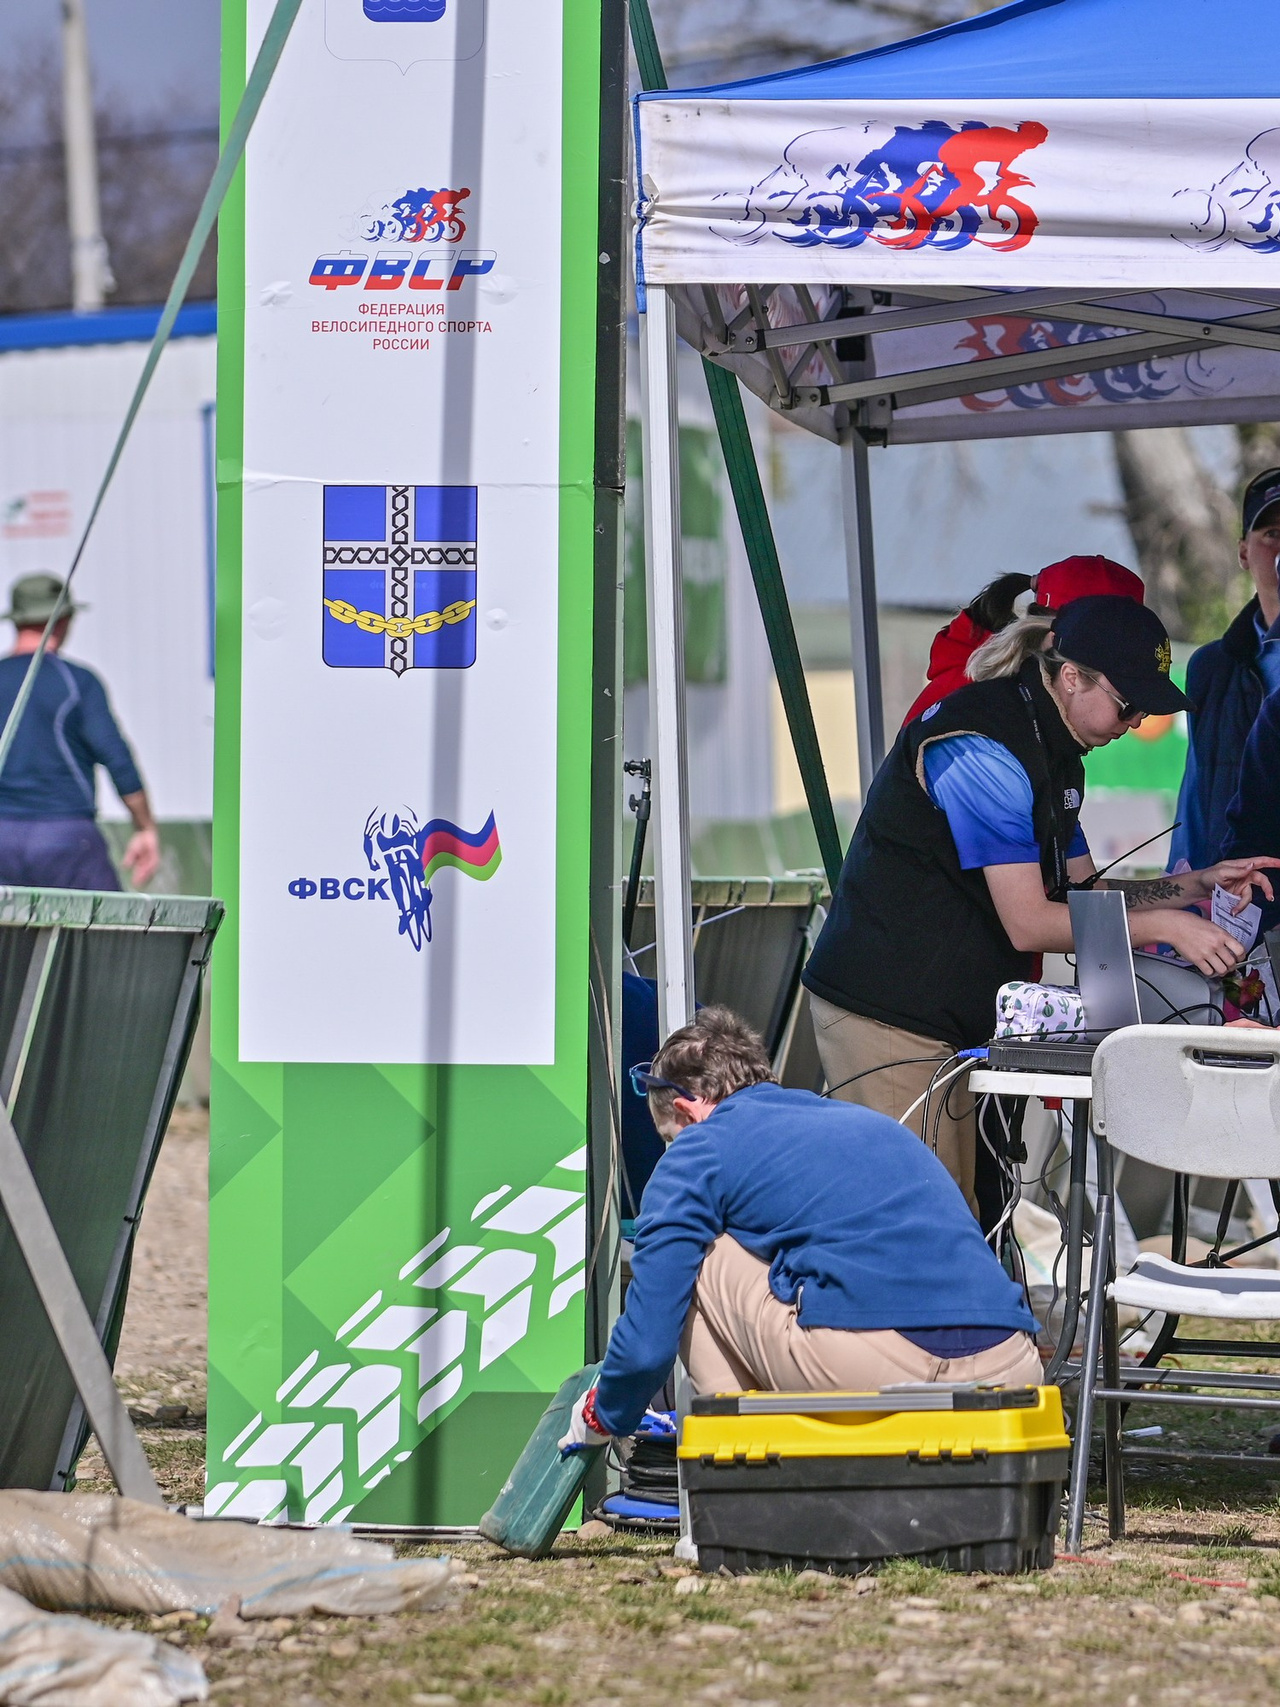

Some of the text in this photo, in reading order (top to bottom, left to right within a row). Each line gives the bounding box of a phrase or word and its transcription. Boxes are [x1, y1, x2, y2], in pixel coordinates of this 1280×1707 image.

[308, 250, 498, 291] ФВСР
[358, 303, 445, 317] ФЕДЕРАЦИЯ
[311, 320, 493, 334] ВЕЛОСИПЕДНОГО СПОРТА
[372, 338, 430, 350] РОССИИ
[287, 877, 391, 901] ФВСК
